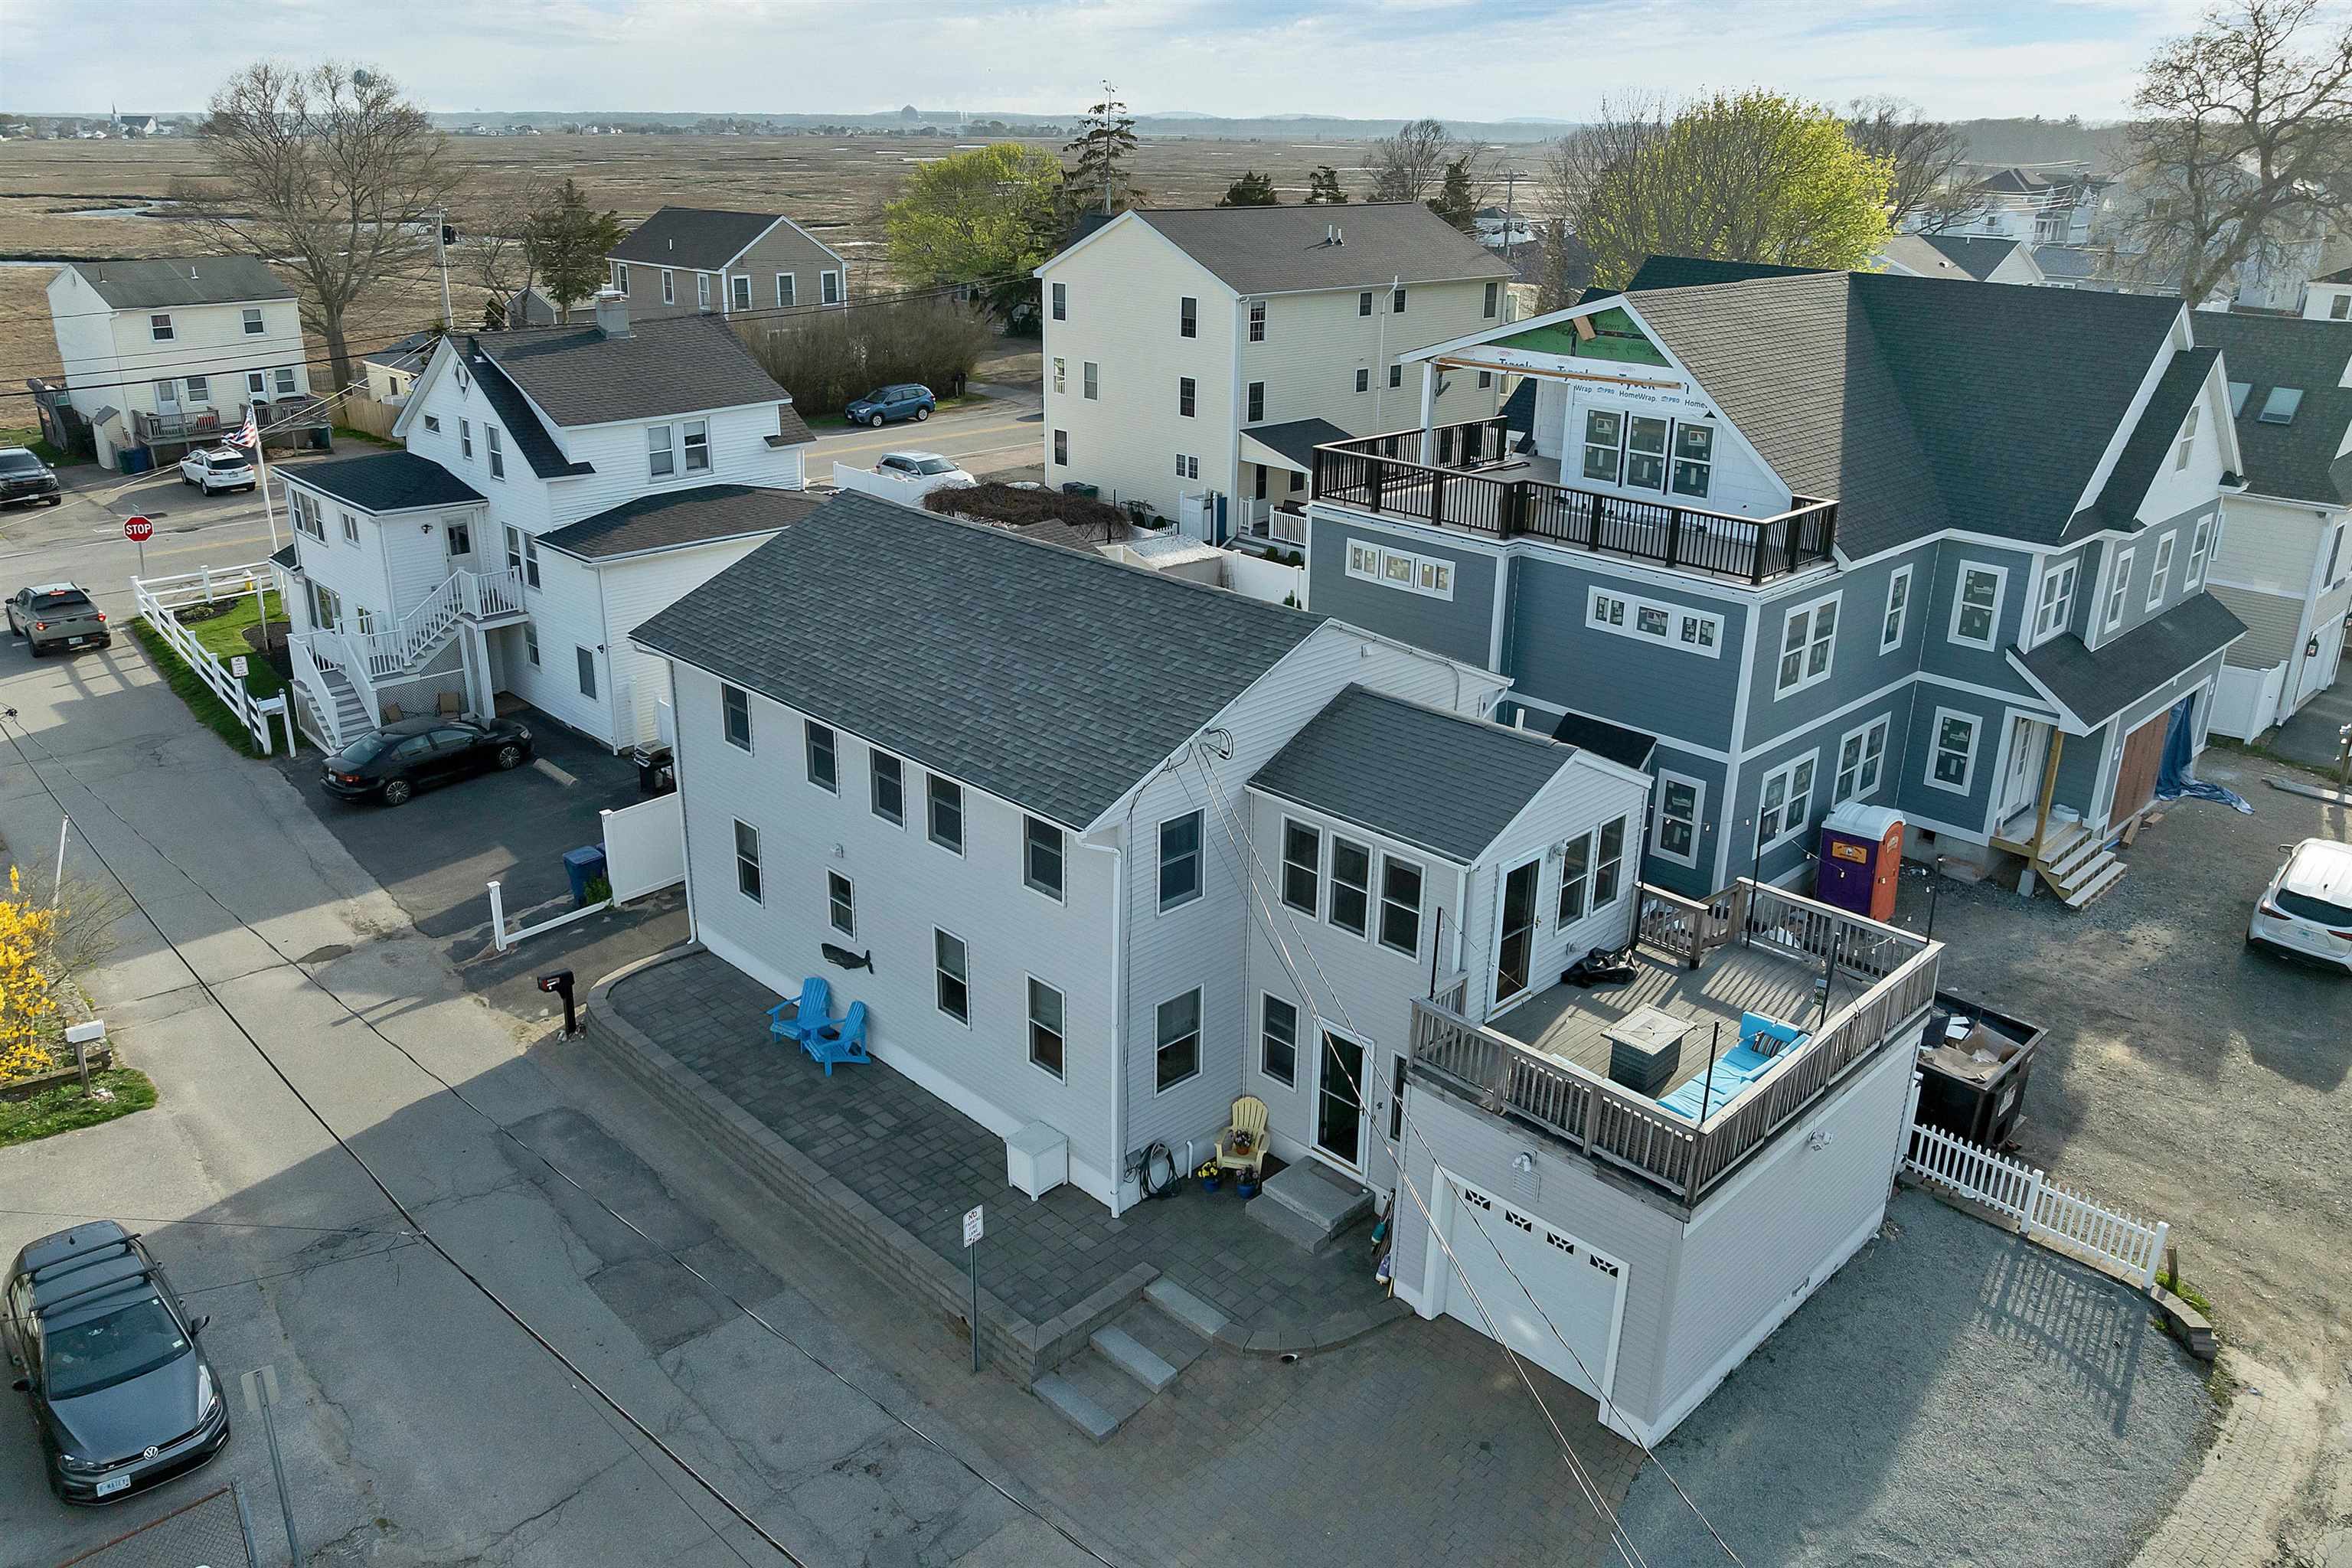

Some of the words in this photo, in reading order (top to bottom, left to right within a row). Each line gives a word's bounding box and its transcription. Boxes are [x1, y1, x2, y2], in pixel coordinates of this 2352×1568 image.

[1619, 390, 1656, 403] HomeWrap
[1684, 399, 1708, 409] Home
[126, 523, 152, 535] STOP
[969, 1211, 977, 1220] NO
